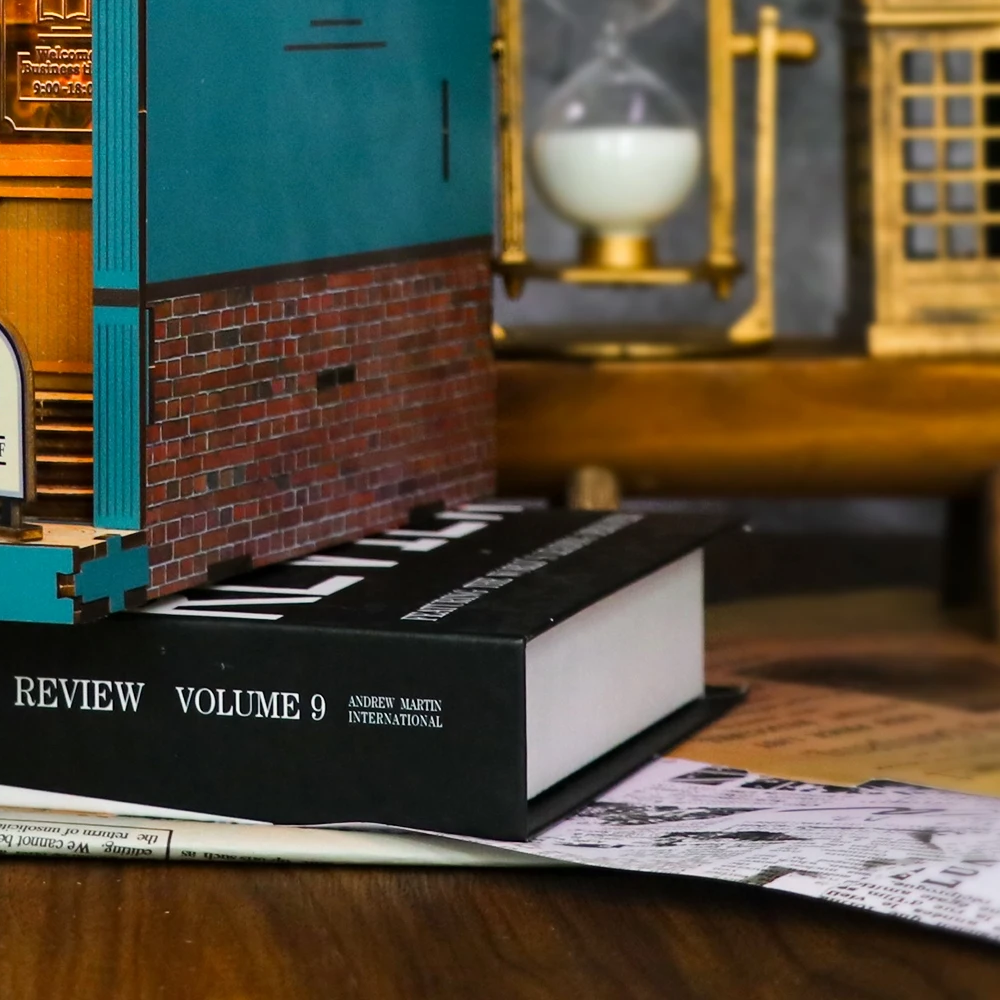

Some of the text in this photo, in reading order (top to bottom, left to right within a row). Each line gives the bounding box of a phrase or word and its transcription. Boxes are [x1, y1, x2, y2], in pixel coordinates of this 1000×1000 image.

[14, 675, 145, 714] REVIEW
[175, 684, 301, 721] VOLUME
[311, 692, 327, 722] 9
[348, 695, 442, 712] ANDREW MARTIN
[348, 710, 443, 729] INTERNATIONAL
[62, 827, 79, 838] of
[137, 833, 159, 846] the
[17, 835, 64, 852] cannot
[67, 840, 91, 854] We
[101, 843, 154, 858] editing.
